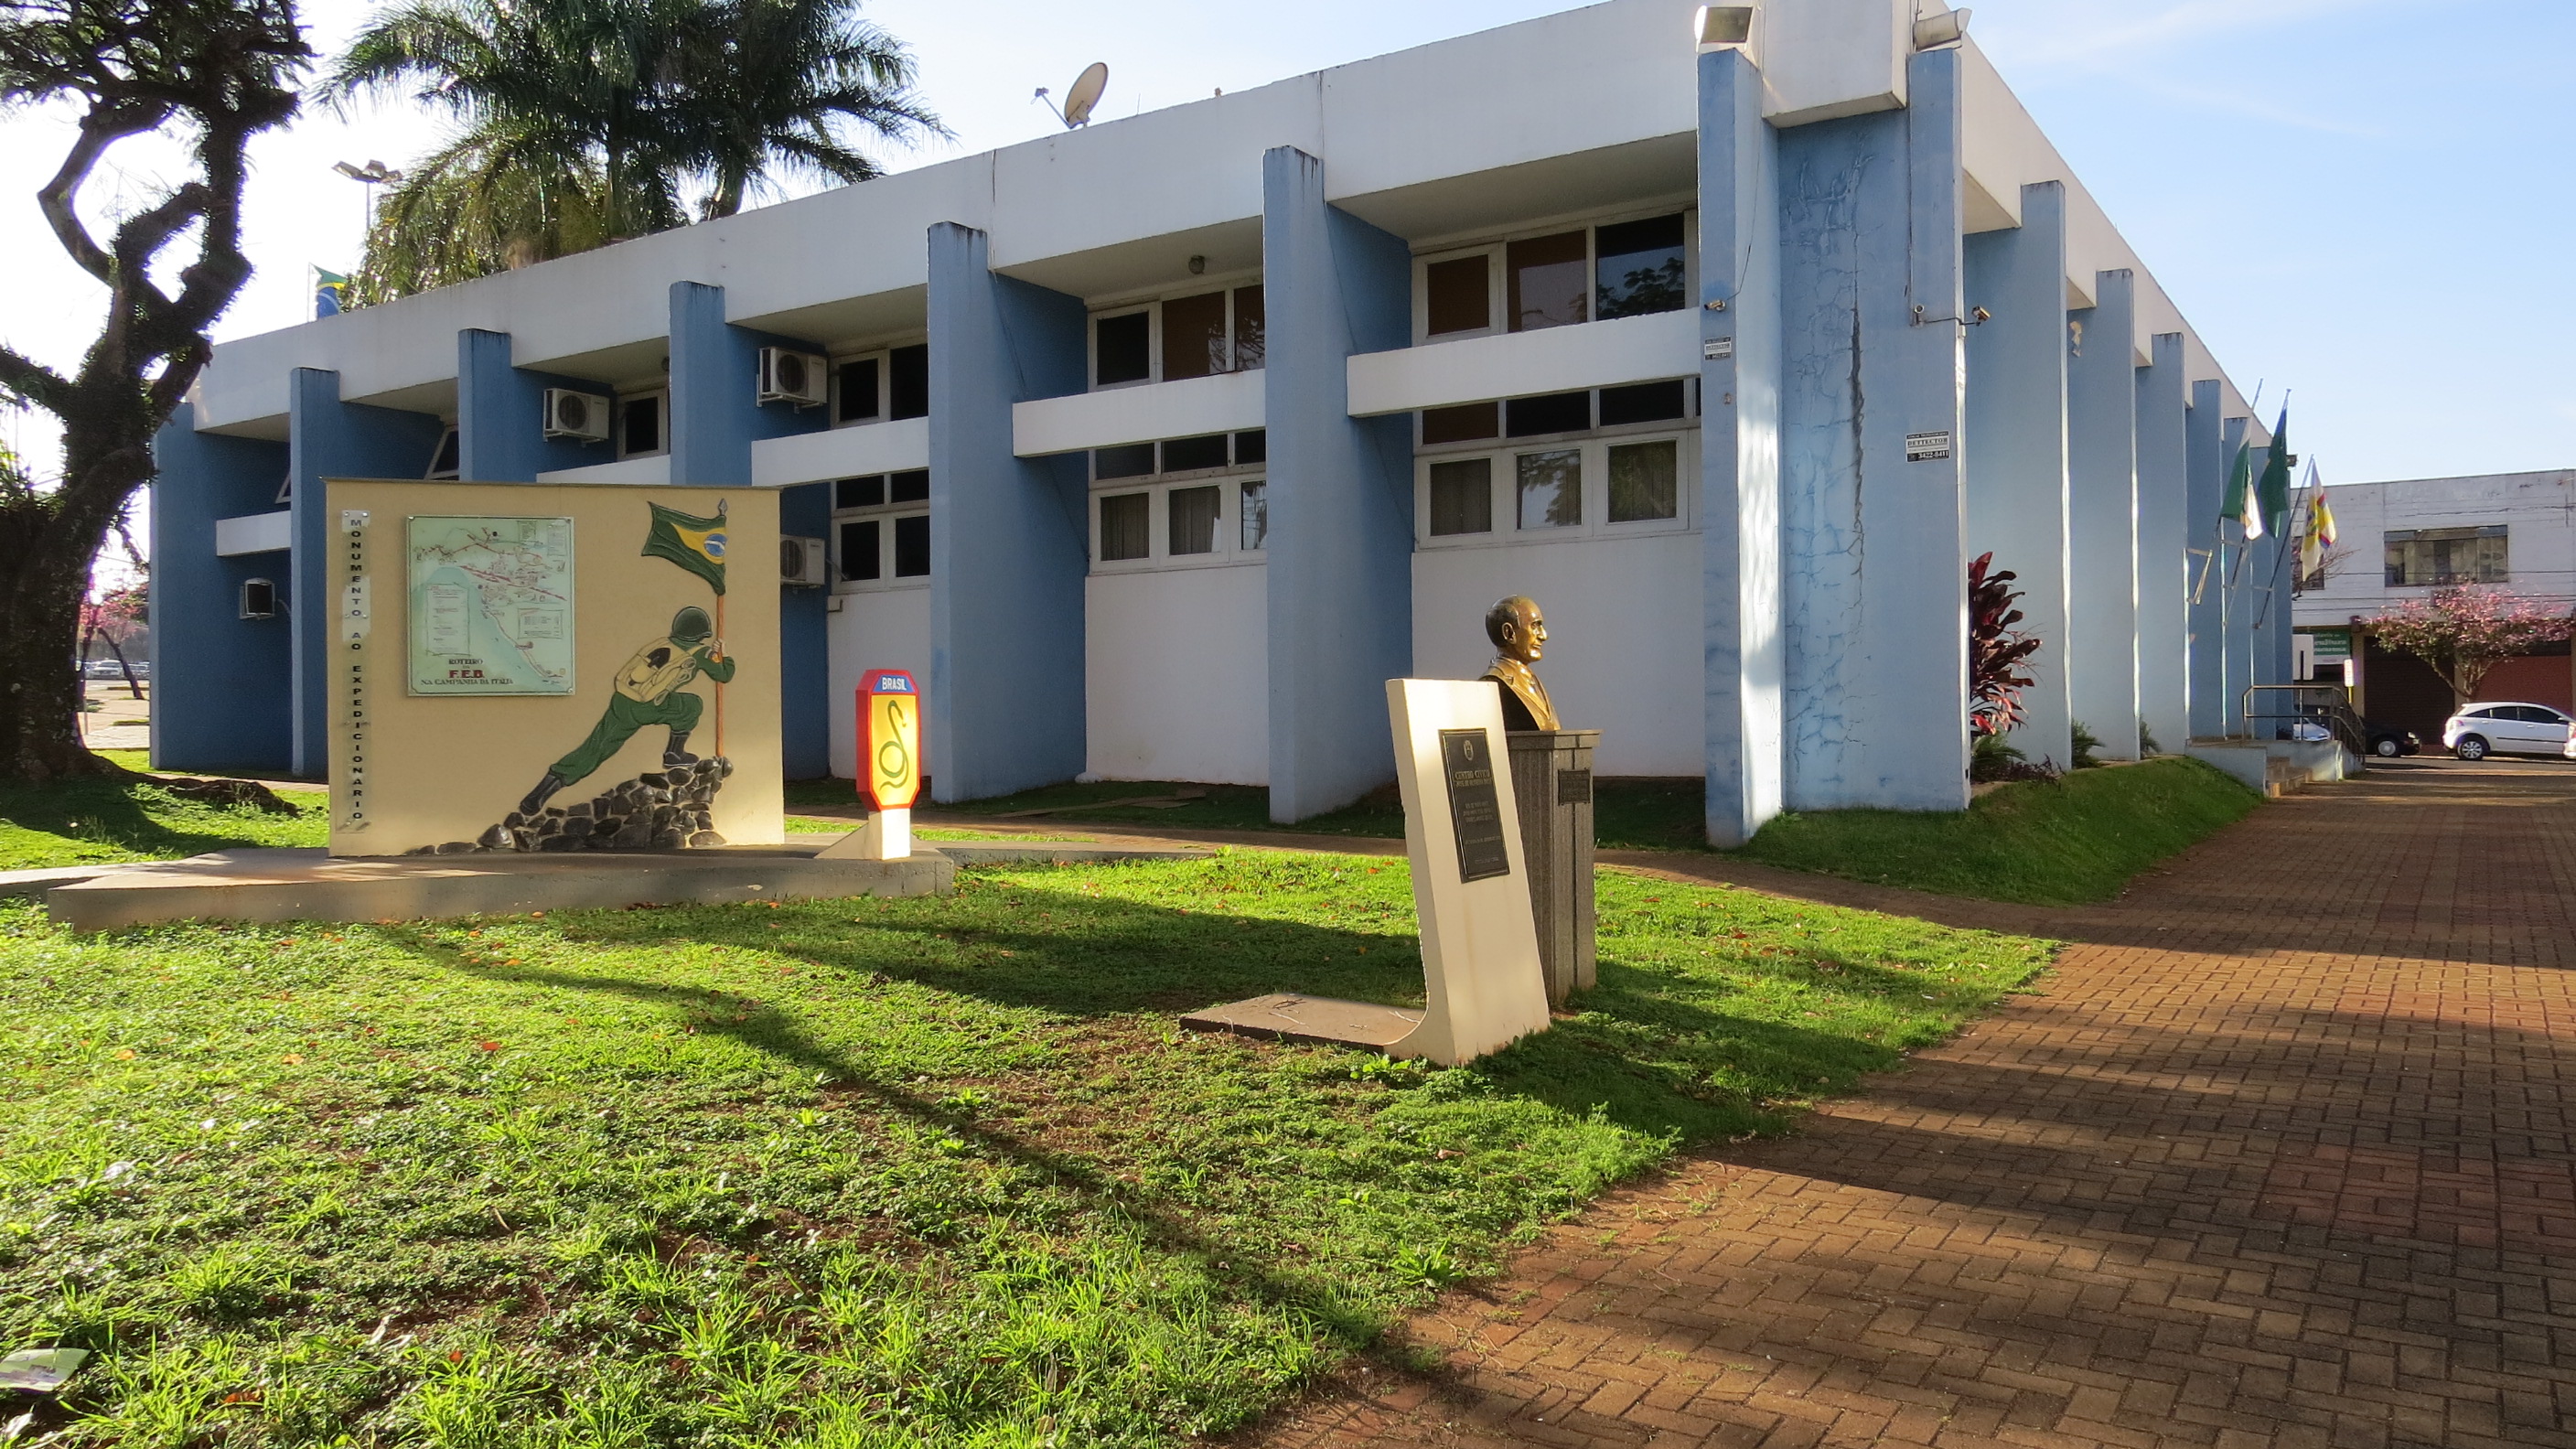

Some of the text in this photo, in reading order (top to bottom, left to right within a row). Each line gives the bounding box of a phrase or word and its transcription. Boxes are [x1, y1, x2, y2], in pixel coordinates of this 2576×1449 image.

[350, 519, 362, 617] MONUMENTO
[351, 632, 361, 650] AO
[882, 677, 907, 691] BRASIL
[352, 665, 363, 820] EXPEDICIONARIO
